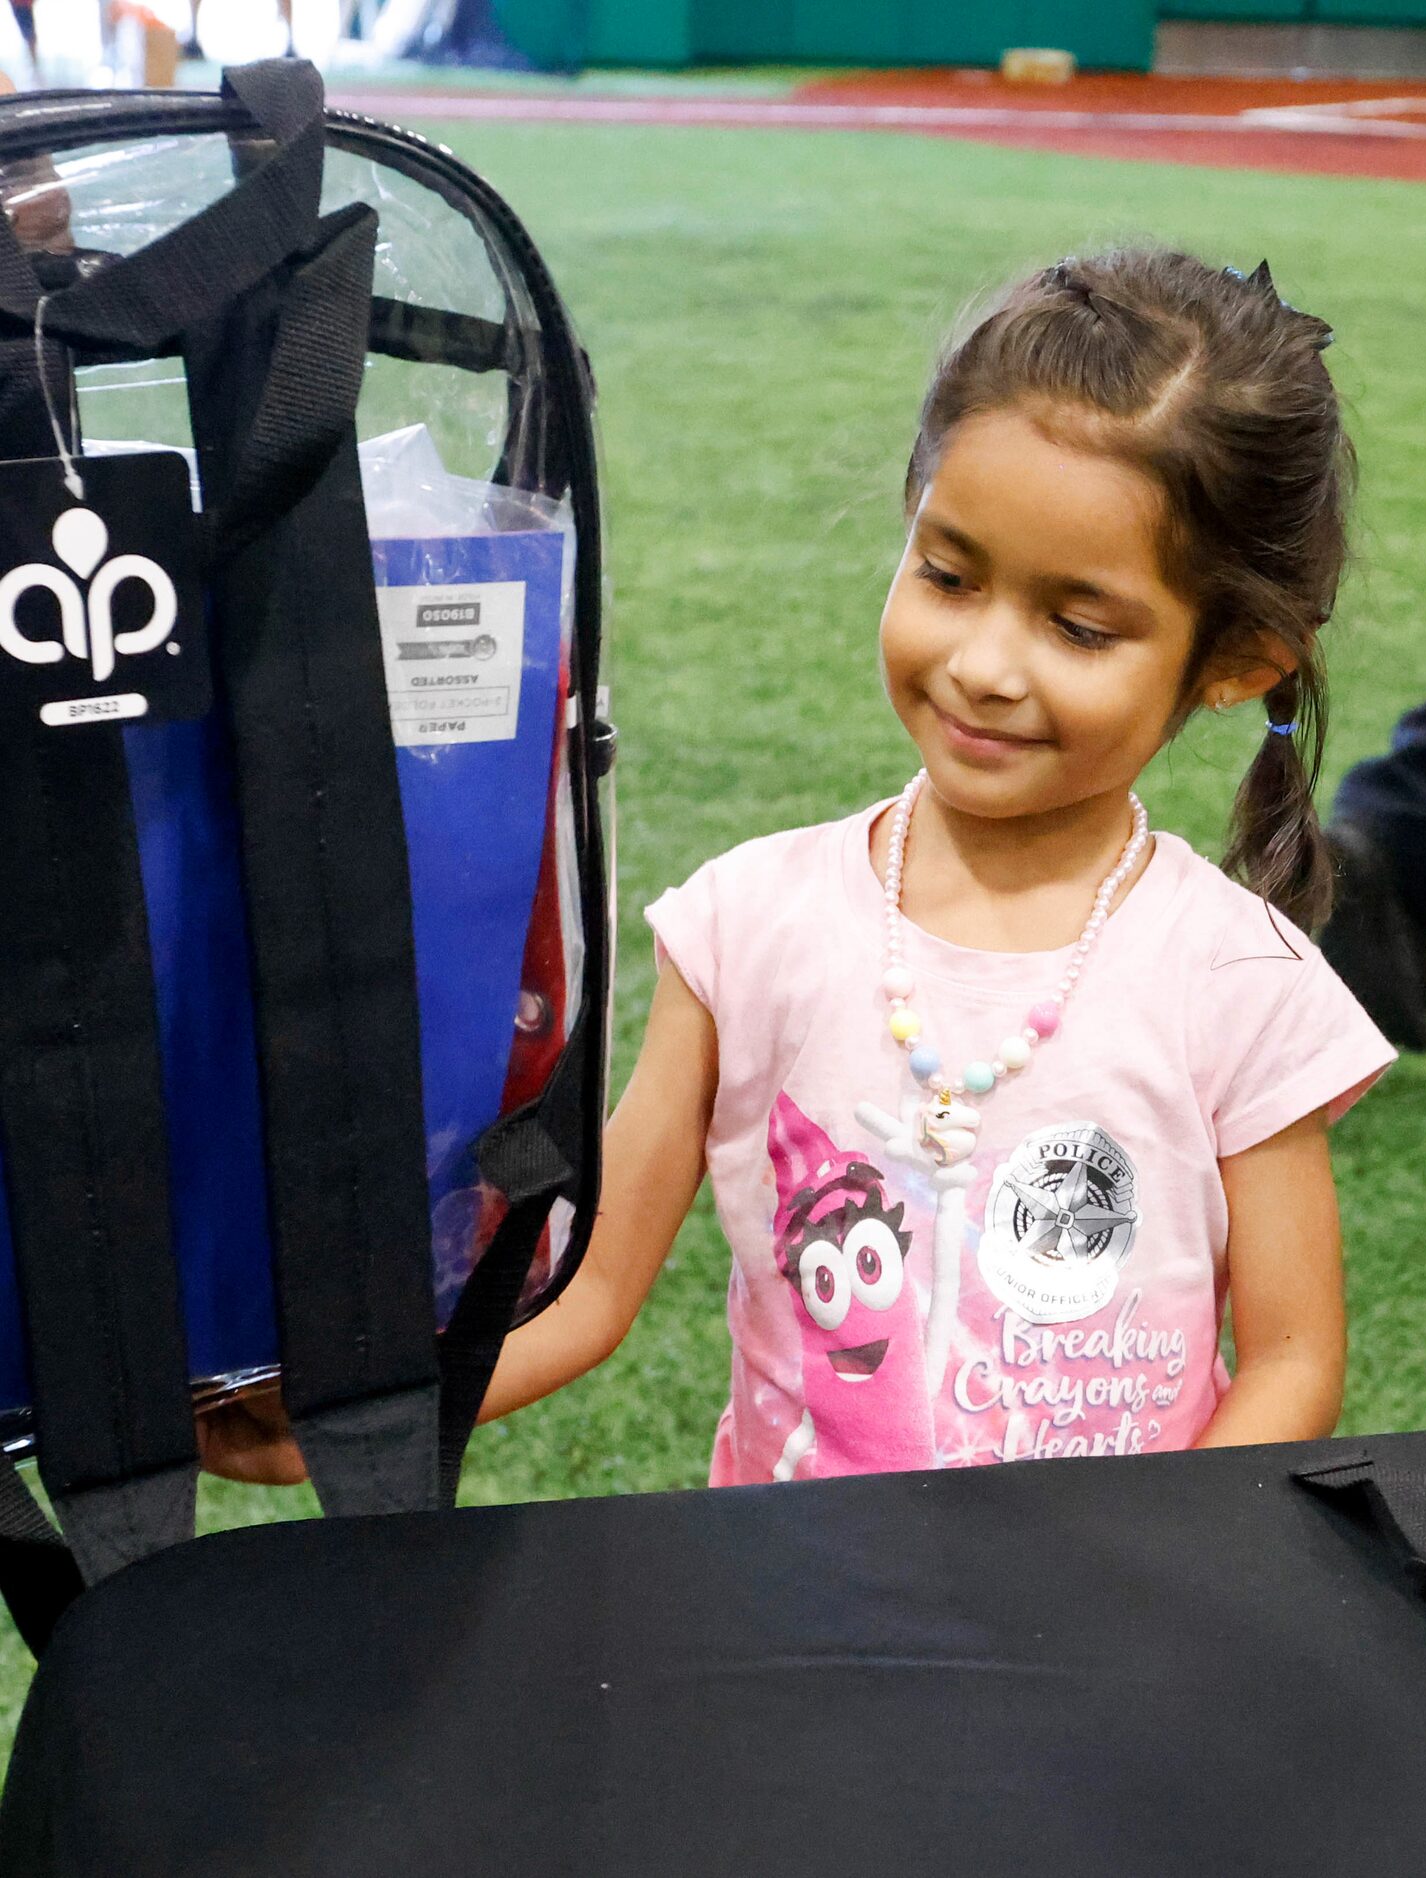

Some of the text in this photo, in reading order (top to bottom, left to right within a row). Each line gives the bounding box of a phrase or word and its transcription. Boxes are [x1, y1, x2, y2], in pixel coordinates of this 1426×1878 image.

[411, 674, 479, 687] ASSORTED
[419, 721, 466, 734] PAPER
[1039, 1143, 1126, 1183] POLICE
[995, 1266, 1036, 1299] UNIOR
[993, 1288, 1187, 1377] Breaking
[954, 1358, 1183, 1427] Crayons and
[993, 1411, 1144, 1462] Hearts
